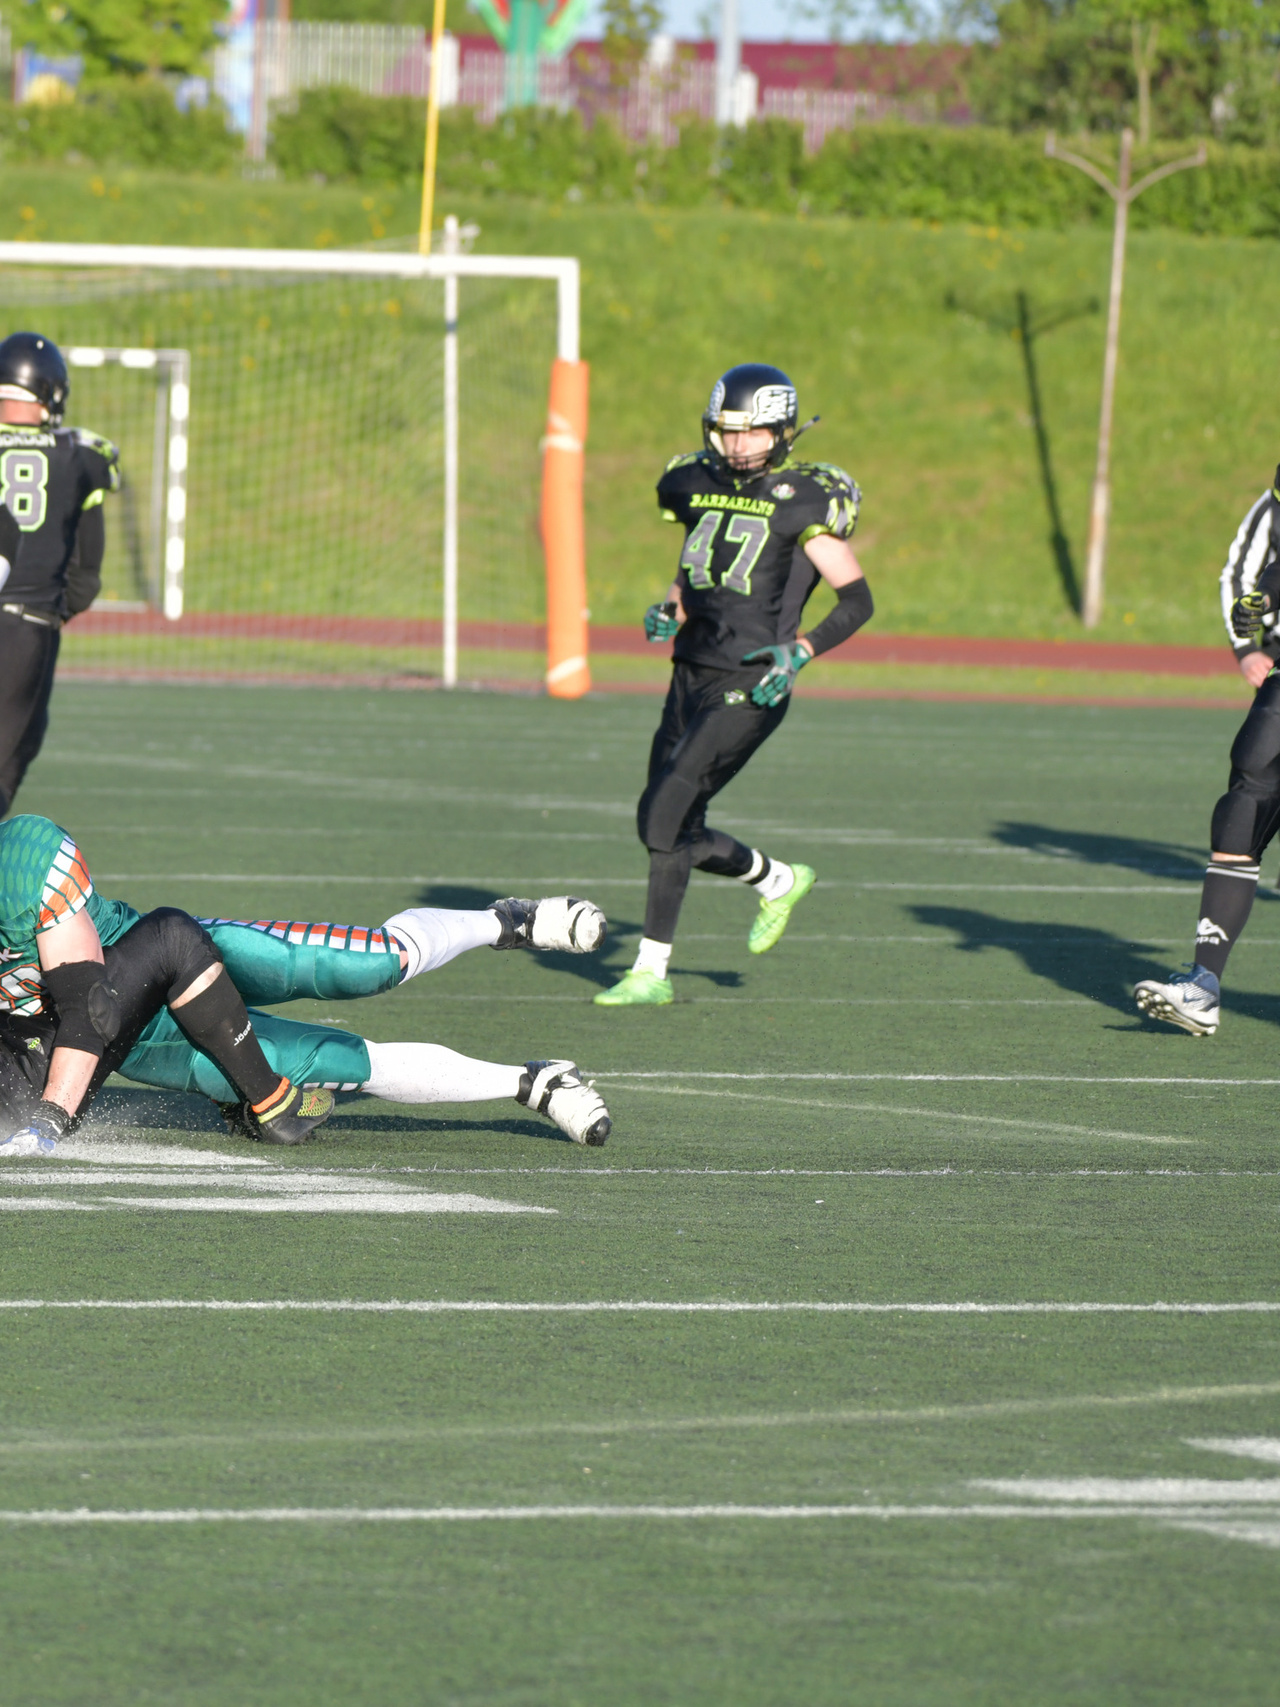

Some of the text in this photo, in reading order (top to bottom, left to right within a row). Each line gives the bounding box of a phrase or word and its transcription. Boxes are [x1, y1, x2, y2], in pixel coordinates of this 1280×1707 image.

[0, 449, 49, 532] 8
[689, 493, 776, 517] BARBARIANS
[681, 510, 770, 595] 47
